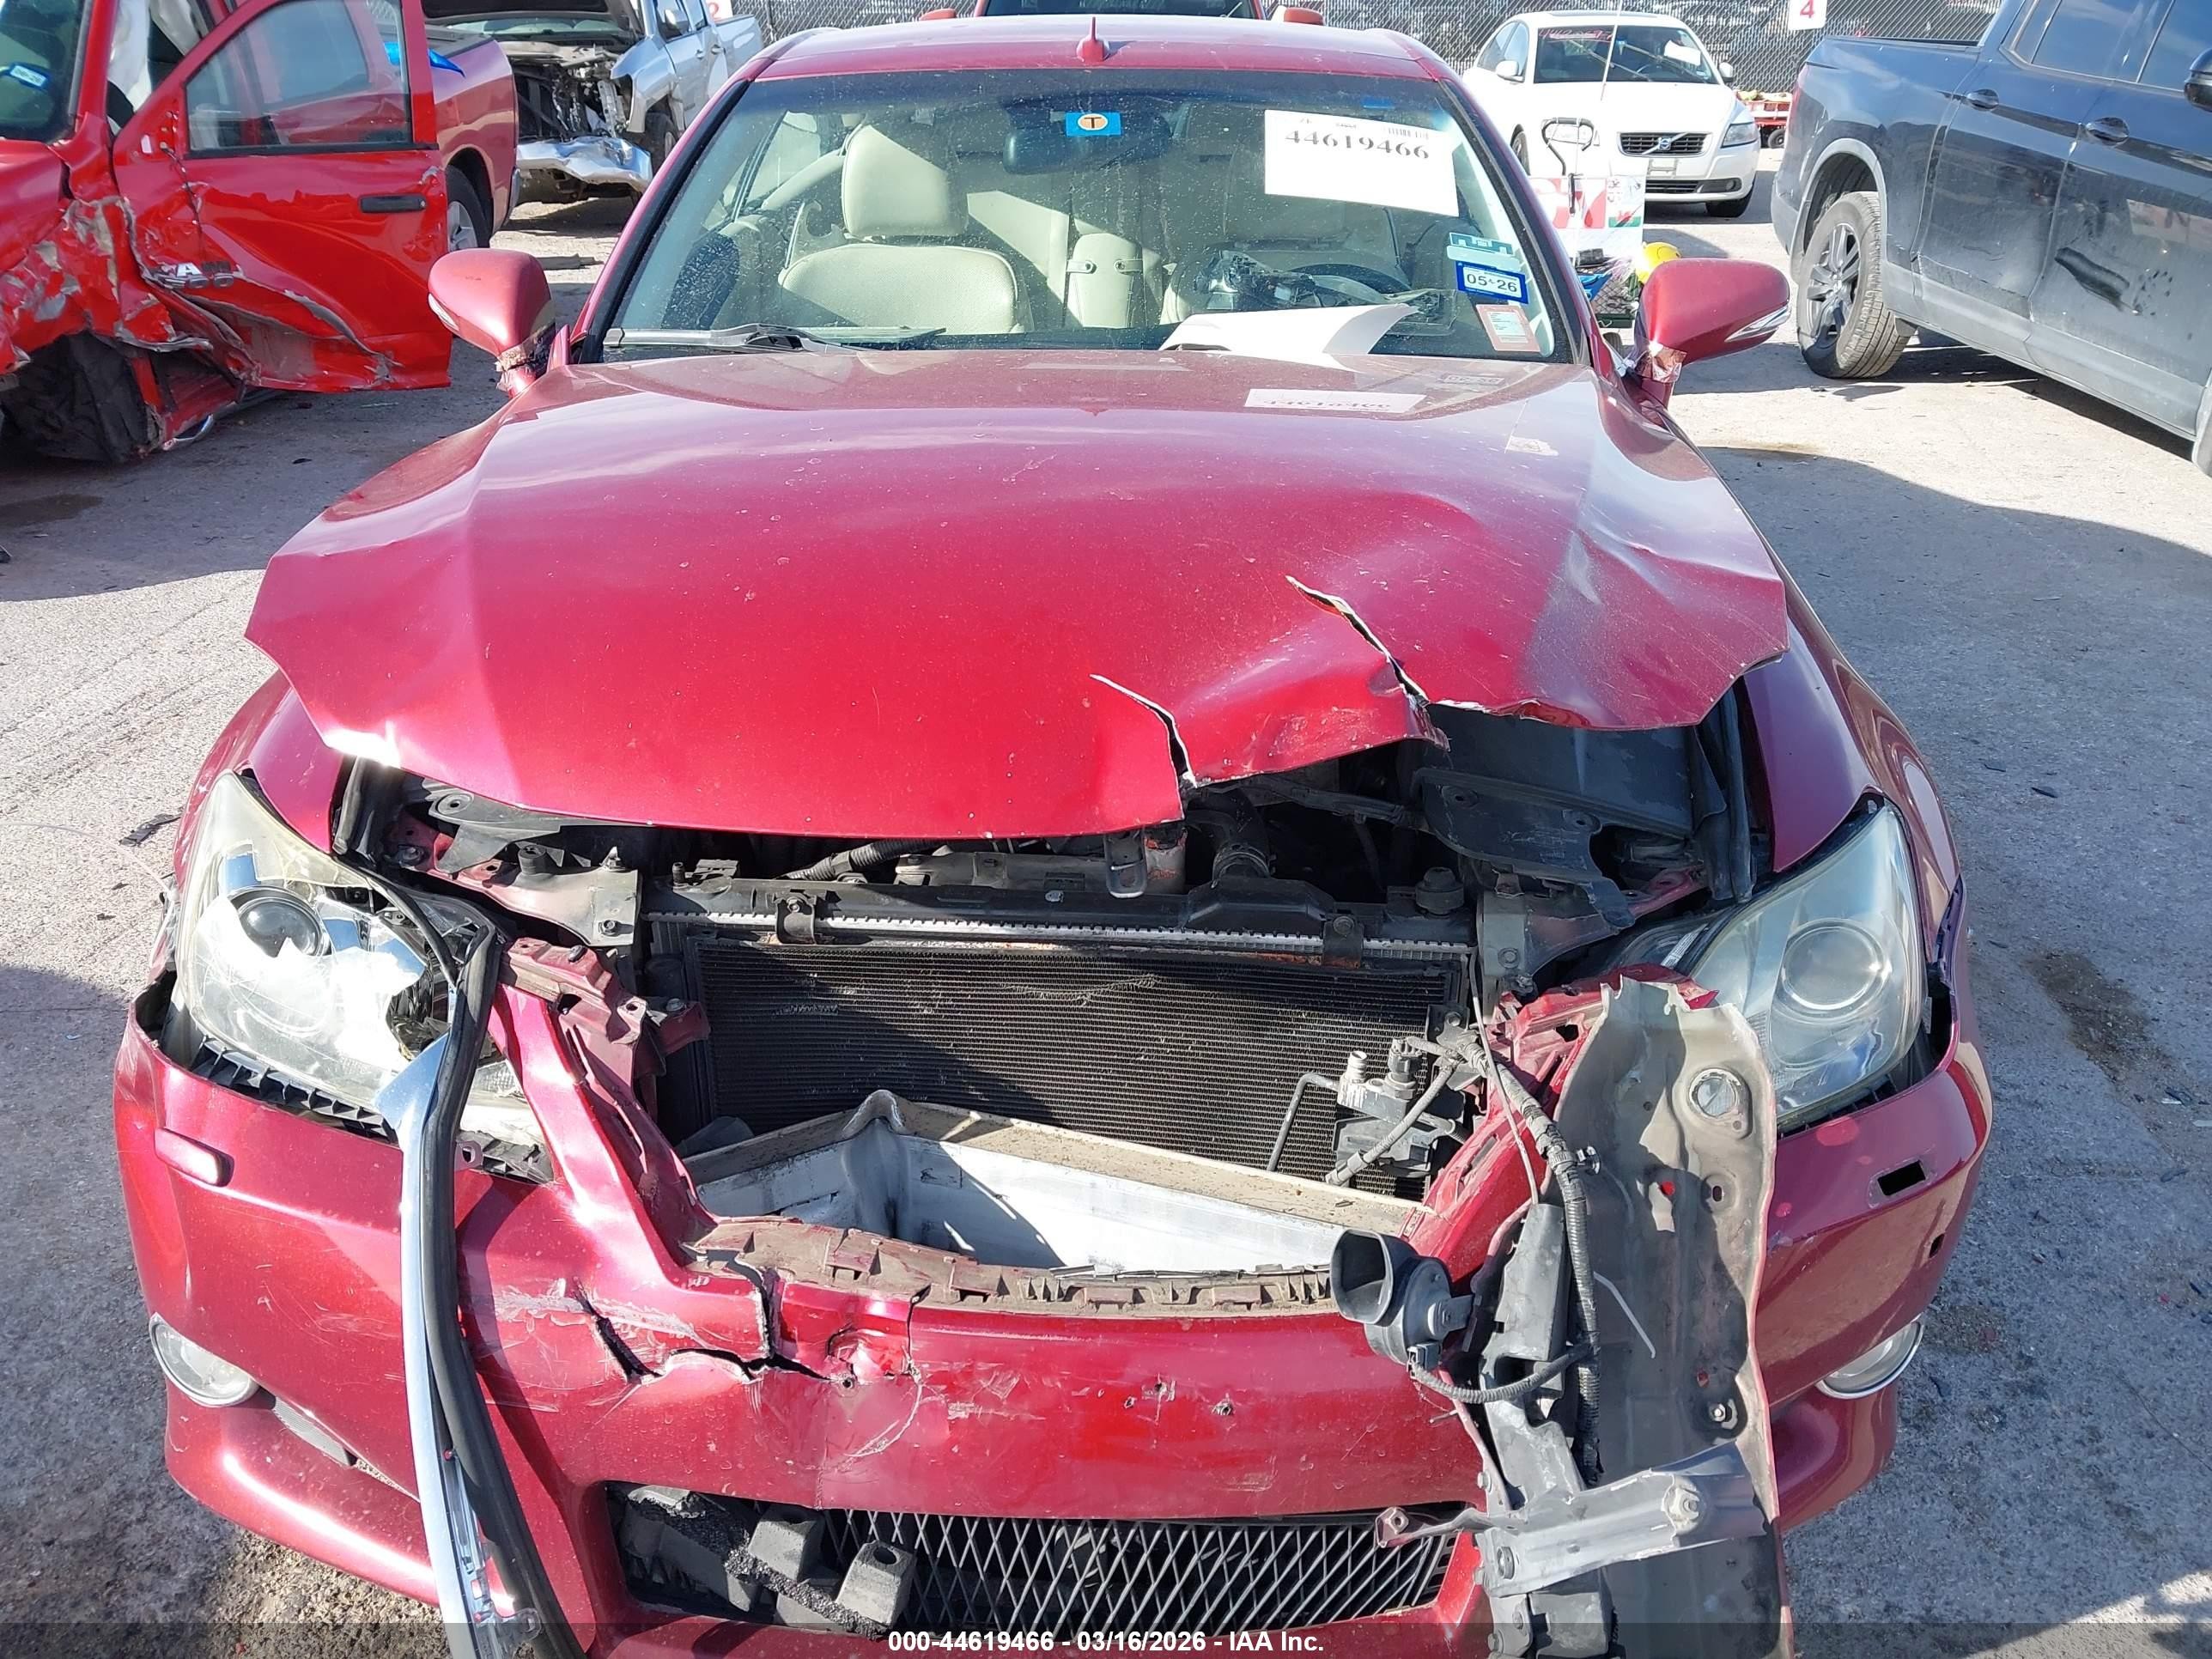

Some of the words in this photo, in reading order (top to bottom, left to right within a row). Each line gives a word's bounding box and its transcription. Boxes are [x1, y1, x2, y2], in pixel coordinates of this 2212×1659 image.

[1800, 0, 1815, 19] 4
[1084, 117, 1102, 129] T
[1285, 131, 1429, 159] 44619466
